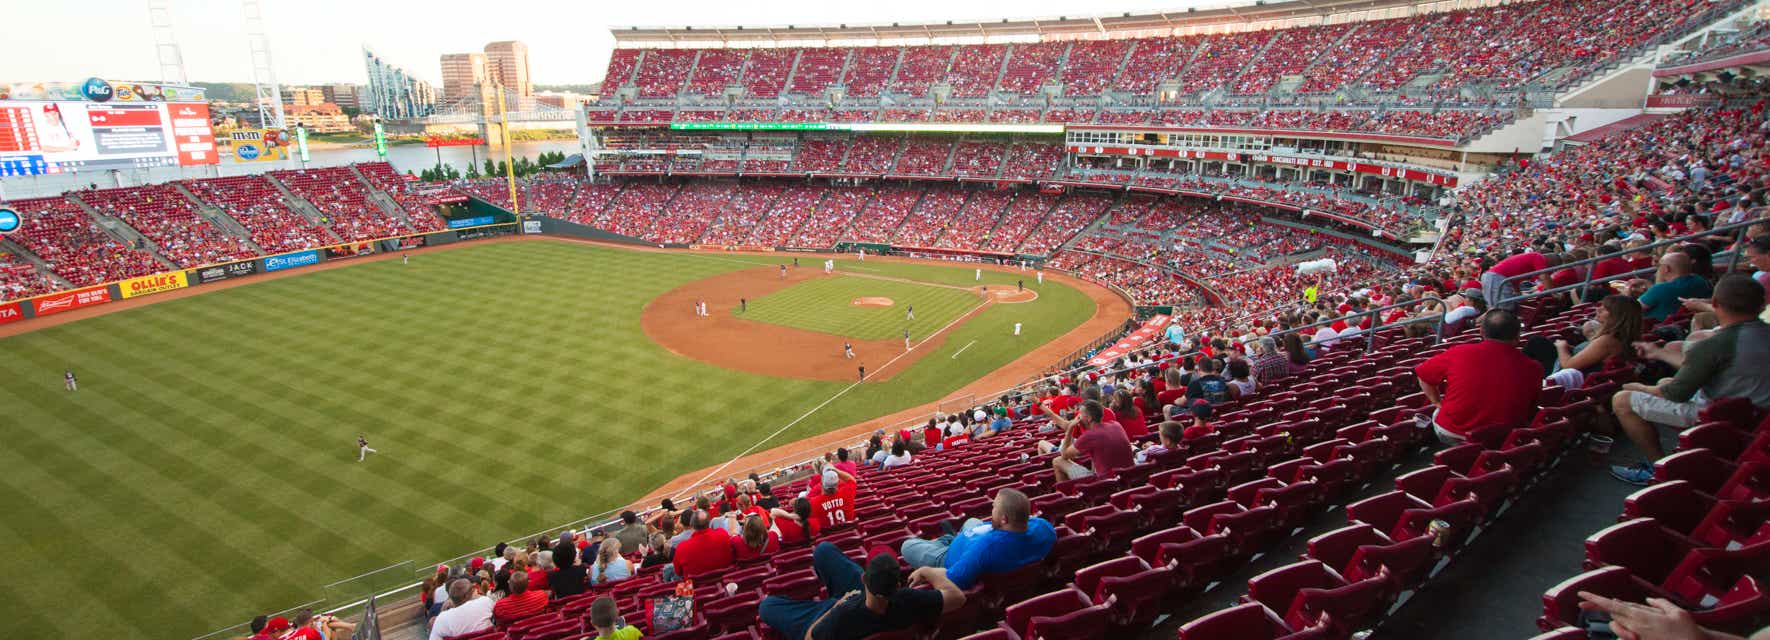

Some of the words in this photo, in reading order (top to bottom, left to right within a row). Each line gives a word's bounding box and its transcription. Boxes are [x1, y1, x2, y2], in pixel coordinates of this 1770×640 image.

[88, 85, 110, 95] P&G
[228, 261, 253, 271] JACK
[131, 275, 177, 290] OLLIE'S
[821, 498, 844, 511] VOTTO
[827, 509, 845, 526] 19
